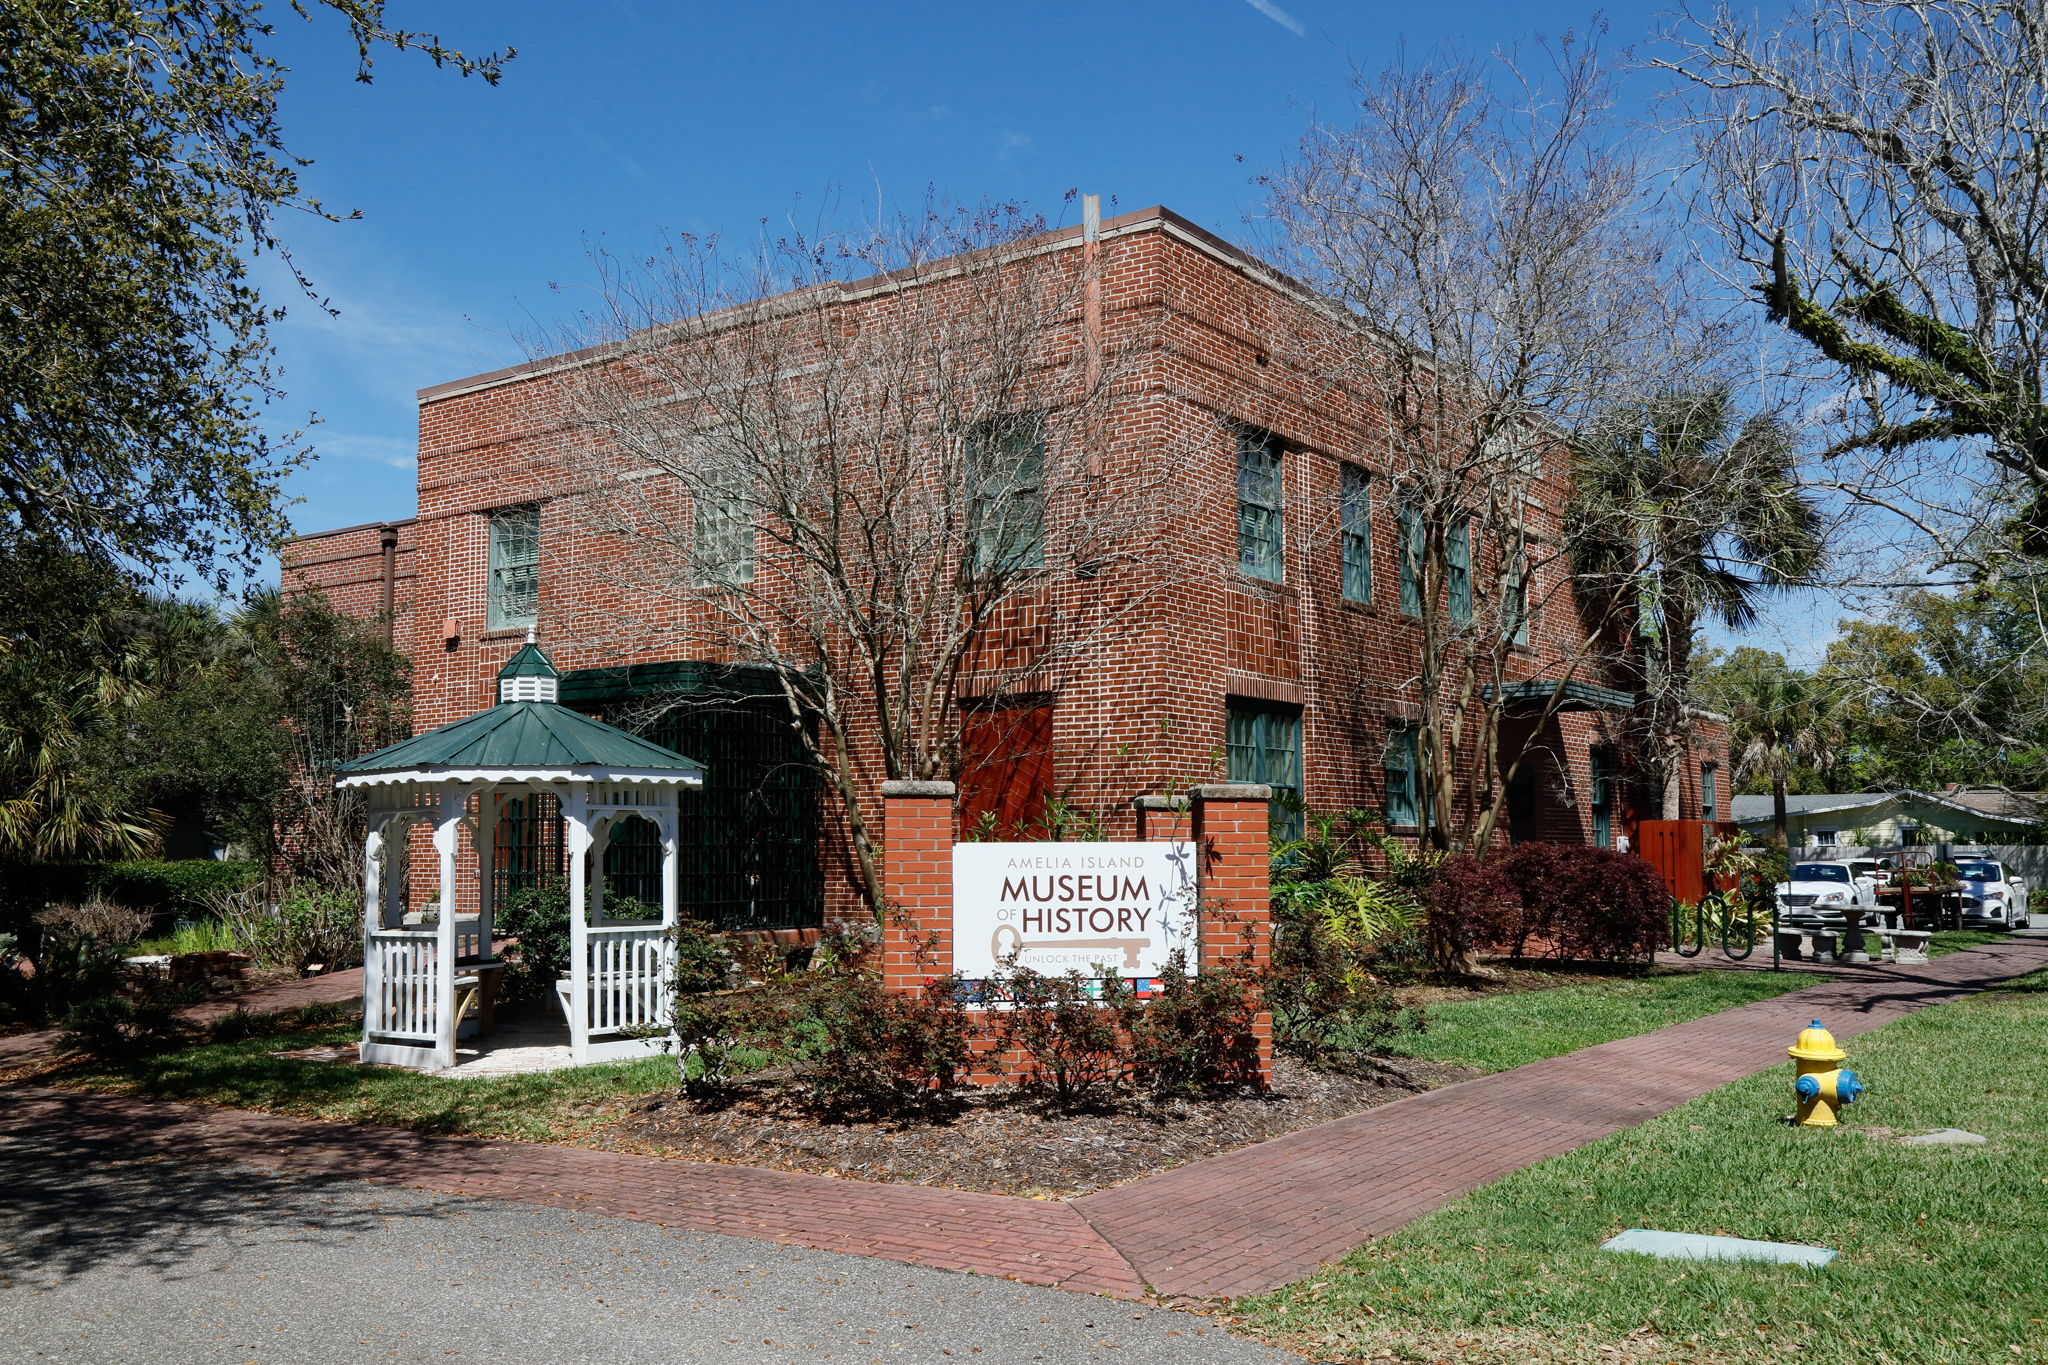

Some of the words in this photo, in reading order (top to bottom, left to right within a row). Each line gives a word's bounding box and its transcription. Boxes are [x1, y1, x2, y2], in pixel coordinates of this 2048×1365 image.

[1007, 856, 1072, 868] AMELIA
[1080, 856, 1145, 868] ISLAND
[1000, 874, 1150, 902] MUSEUM
[996, 909, 1017, 921] OF
[1022, 908, 1152, 933] HISTORY
[1024, 954, 1070, 964] UNLOCK
[1072, 954, 1092, 963] THE
[1094, 954, 1118, 962] PAST
